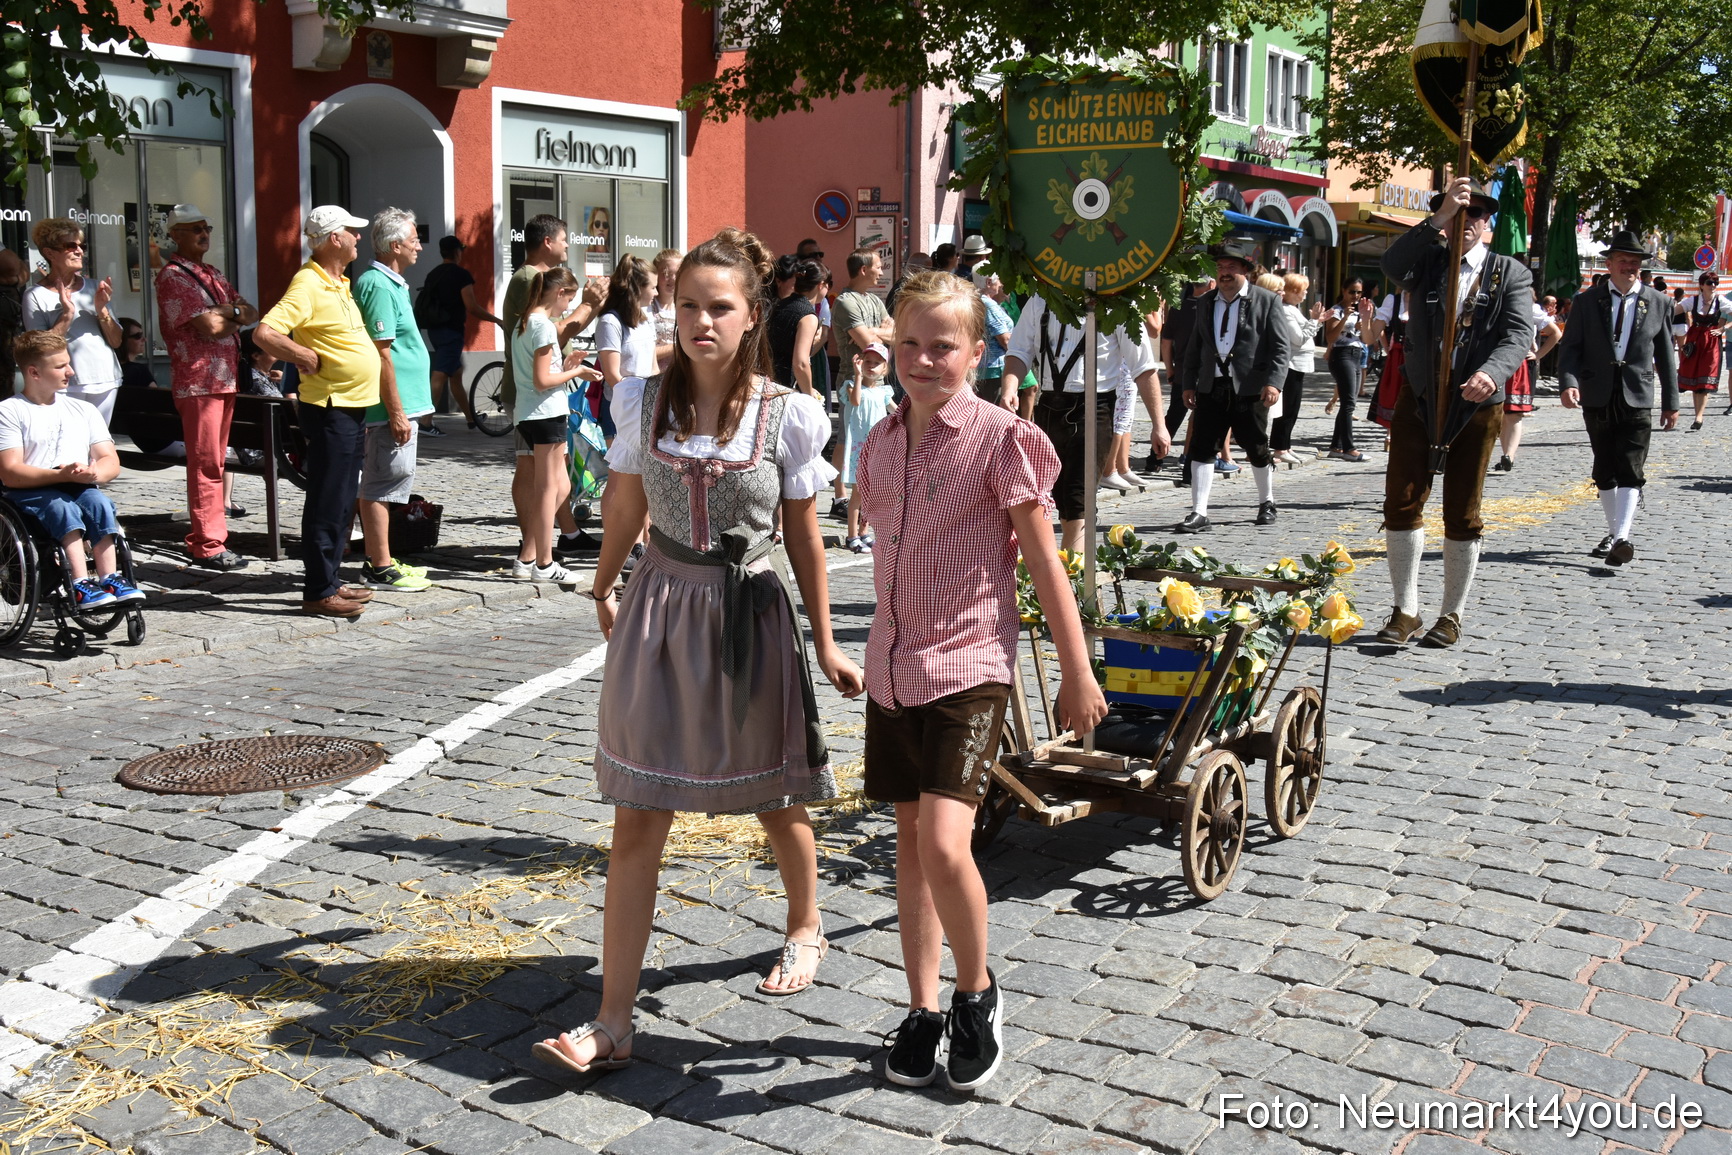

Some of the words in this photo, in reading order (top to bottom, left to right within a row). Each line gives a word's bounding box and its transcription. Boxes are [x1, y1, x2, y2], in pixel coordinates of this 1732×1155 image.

[1028, 90, 1167, 121] SCHÜTZENVER
[1036, 120, 1154, 146] EICHENLAUB
[1380, 182, 1405, 208] LEDER
[1034, 239, 1155, 286] PAVESBACH
